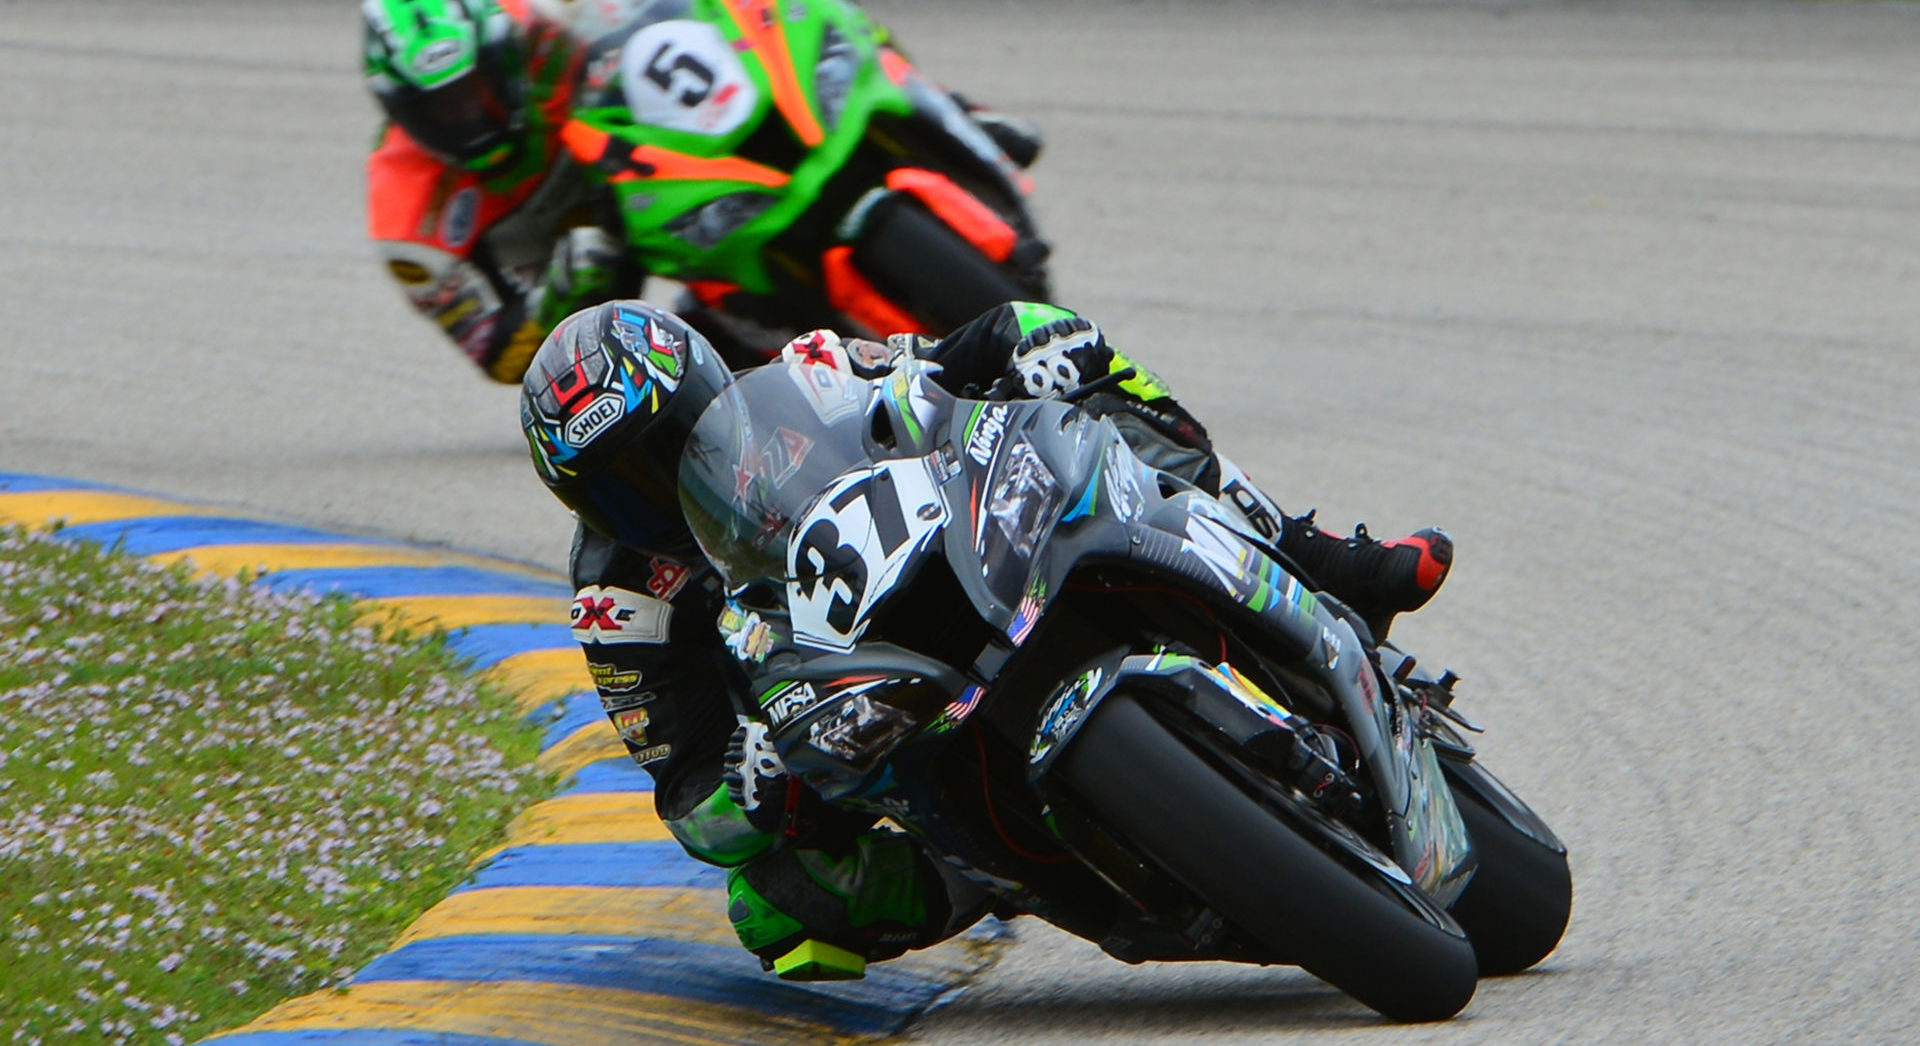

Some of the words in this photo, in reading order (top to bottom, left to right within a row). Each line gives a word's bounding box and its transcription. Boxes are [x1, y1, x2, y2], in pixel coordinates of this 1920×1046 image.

[645, 41, 714, 107] 5
[571, 400, 617, 441] SHOEI
[969, 404, 1009, 466] Ninja
[795, 467, 910, 635] 37
